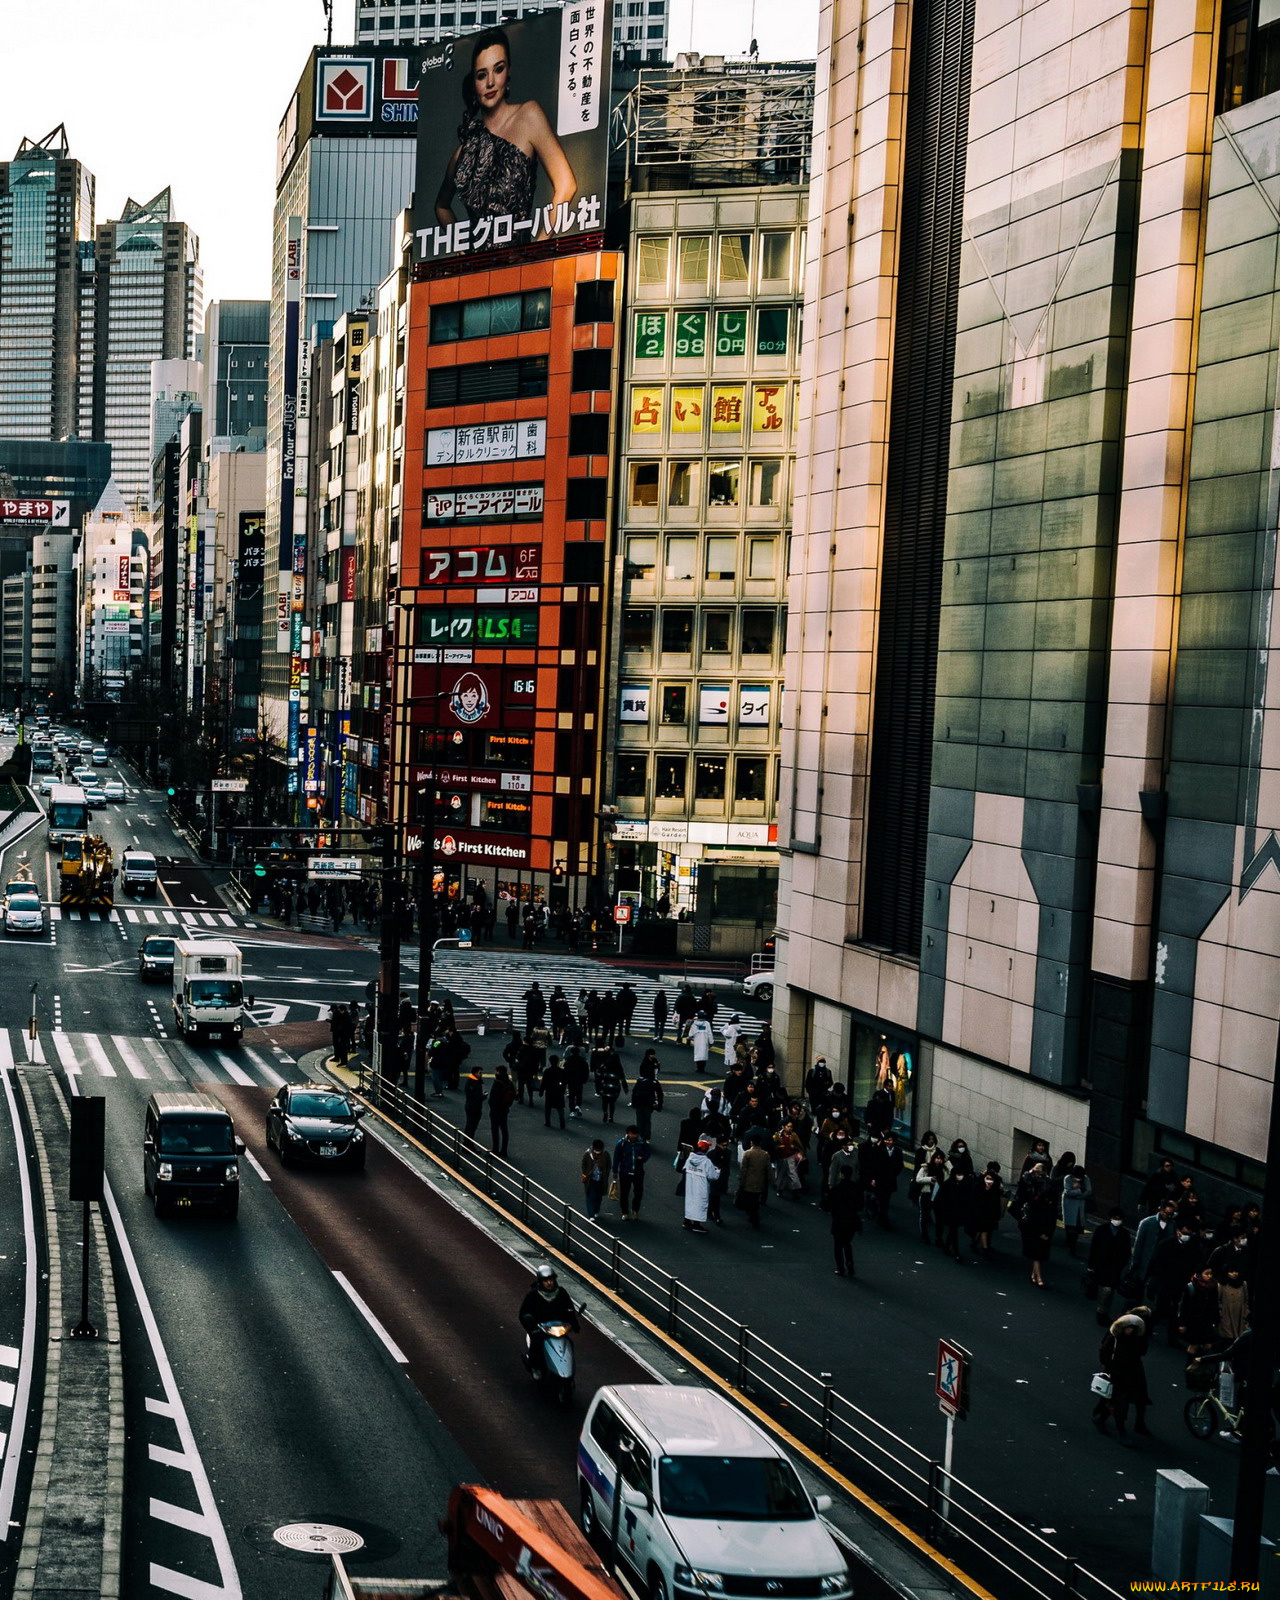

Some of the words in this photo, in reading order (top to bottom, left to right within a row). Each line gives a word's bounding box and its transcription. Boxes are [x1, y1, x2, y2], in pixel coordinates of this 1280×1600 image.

[421, 54, 445, 74] global
[567, 10, 581, 99] 面白くする。
[580, 6, 596, 123] 世界の不動産を
[416, 194, 602, 259] THEグローバル社
[289, 240, 297, 266] LABI
[642, 313, 741, 336] ほぐし
[759, 340, 787, 351] 60分
[634, 396, 742, 426] 占い館
[458, 426, 515, 446] 新宿駅前
[527, 423, 538, 455] 歯科
[436, 445, 517, 463] デンタルクリニック
[3, 501, 49, 516] やまや
[456, 496, 542, 516] エーアイアール
[429, 550, 507, 580] アコム
[520, 549, 536, 562] 6F
[511, 590, 535, 600] アコム
[279, 593, 287, 618] LABI
[290, 658, 300, 684] トレカ
[513, 680, 535, 693] 16:16
[622, 699, 646, 713] 賃貸
[741, 702, 768, 716] タイ
[452, 775, 468, 783] First
[471, 776, 497, 784] Kitchen
[736, 831, 759, 839] AQUA
[458, 842, 483, 854] First
[484, 845, 527, 859] Kitchen
[475, 1505, 505, 1543] UNIC
